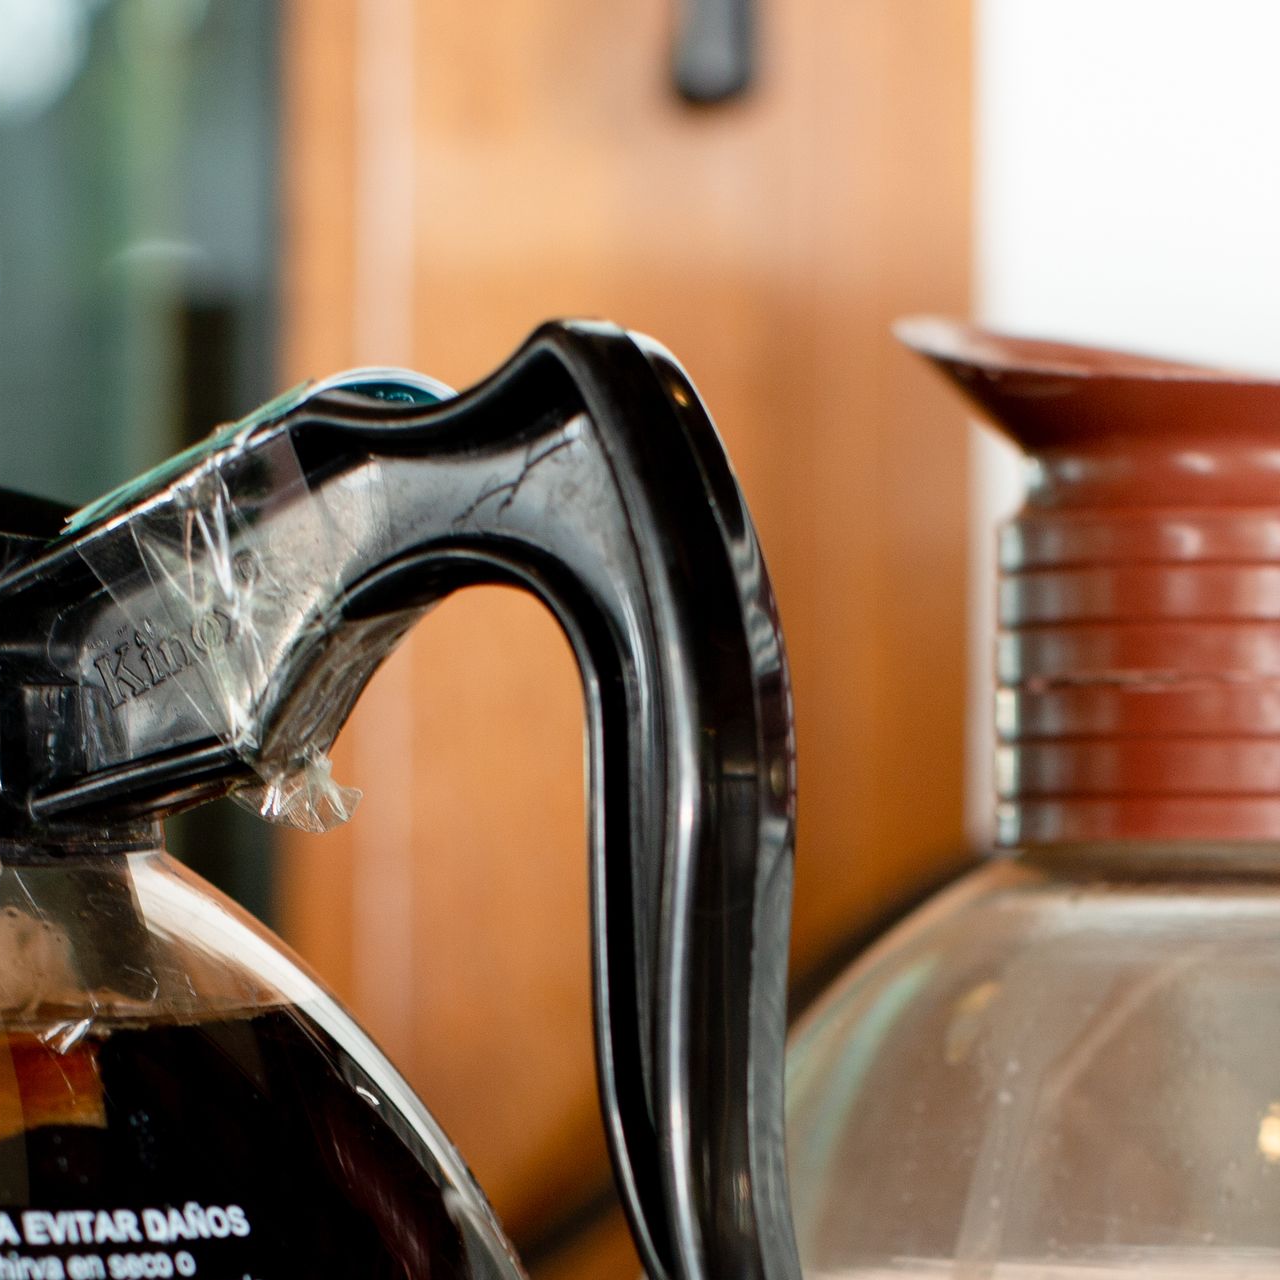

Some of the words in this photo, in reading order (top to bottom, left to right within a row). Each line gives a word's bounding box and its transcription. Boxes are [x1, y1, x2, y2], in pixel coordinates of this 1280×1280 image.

[22, 1209, 144, 1246] EVITAR
[141, 1200, 251, 1244] DAÑOS
[66, 1253, 107, 1280] en
[107, 1252, 175, 1280] seco
[175, 1250, 197, 1277] o
